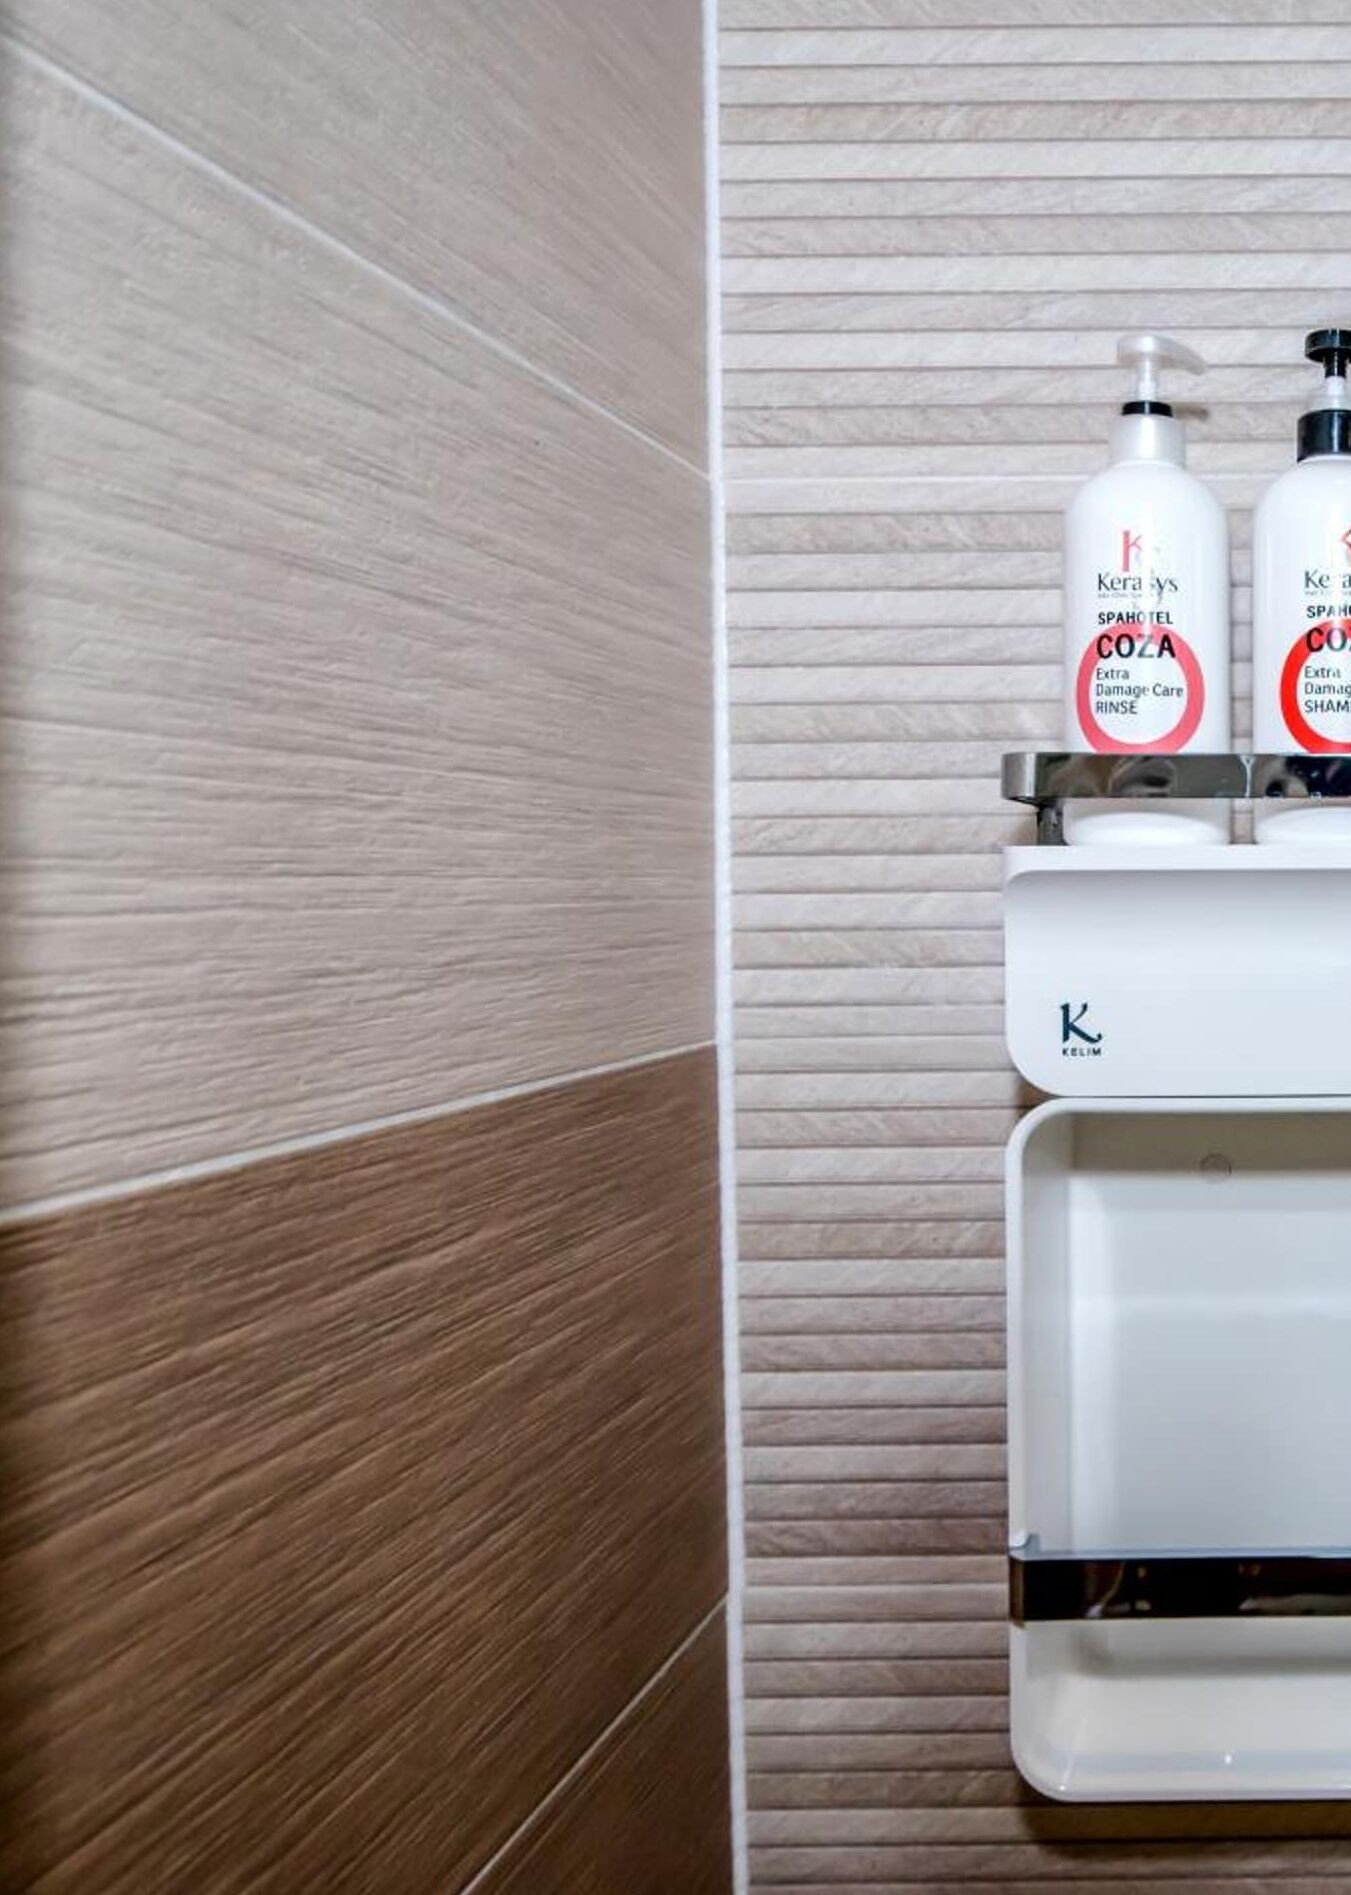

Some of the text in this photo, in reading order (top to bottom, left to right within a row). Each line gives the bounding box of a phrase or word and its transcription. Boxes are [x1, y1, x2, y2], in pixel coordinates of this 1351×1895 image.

[1097, 572, 1178, 604] Kerays
[1098, 611, 1174, 625] SPAHOTEL
[1096, 633, 1176, 659] COZA
[1096, 667, 1130, 680] Extra
[1304, 665, 1341, 678] Extra
[1096, 684, 1184, 698] Damage Care
[1096, 701, 1138, 714] RINSE
